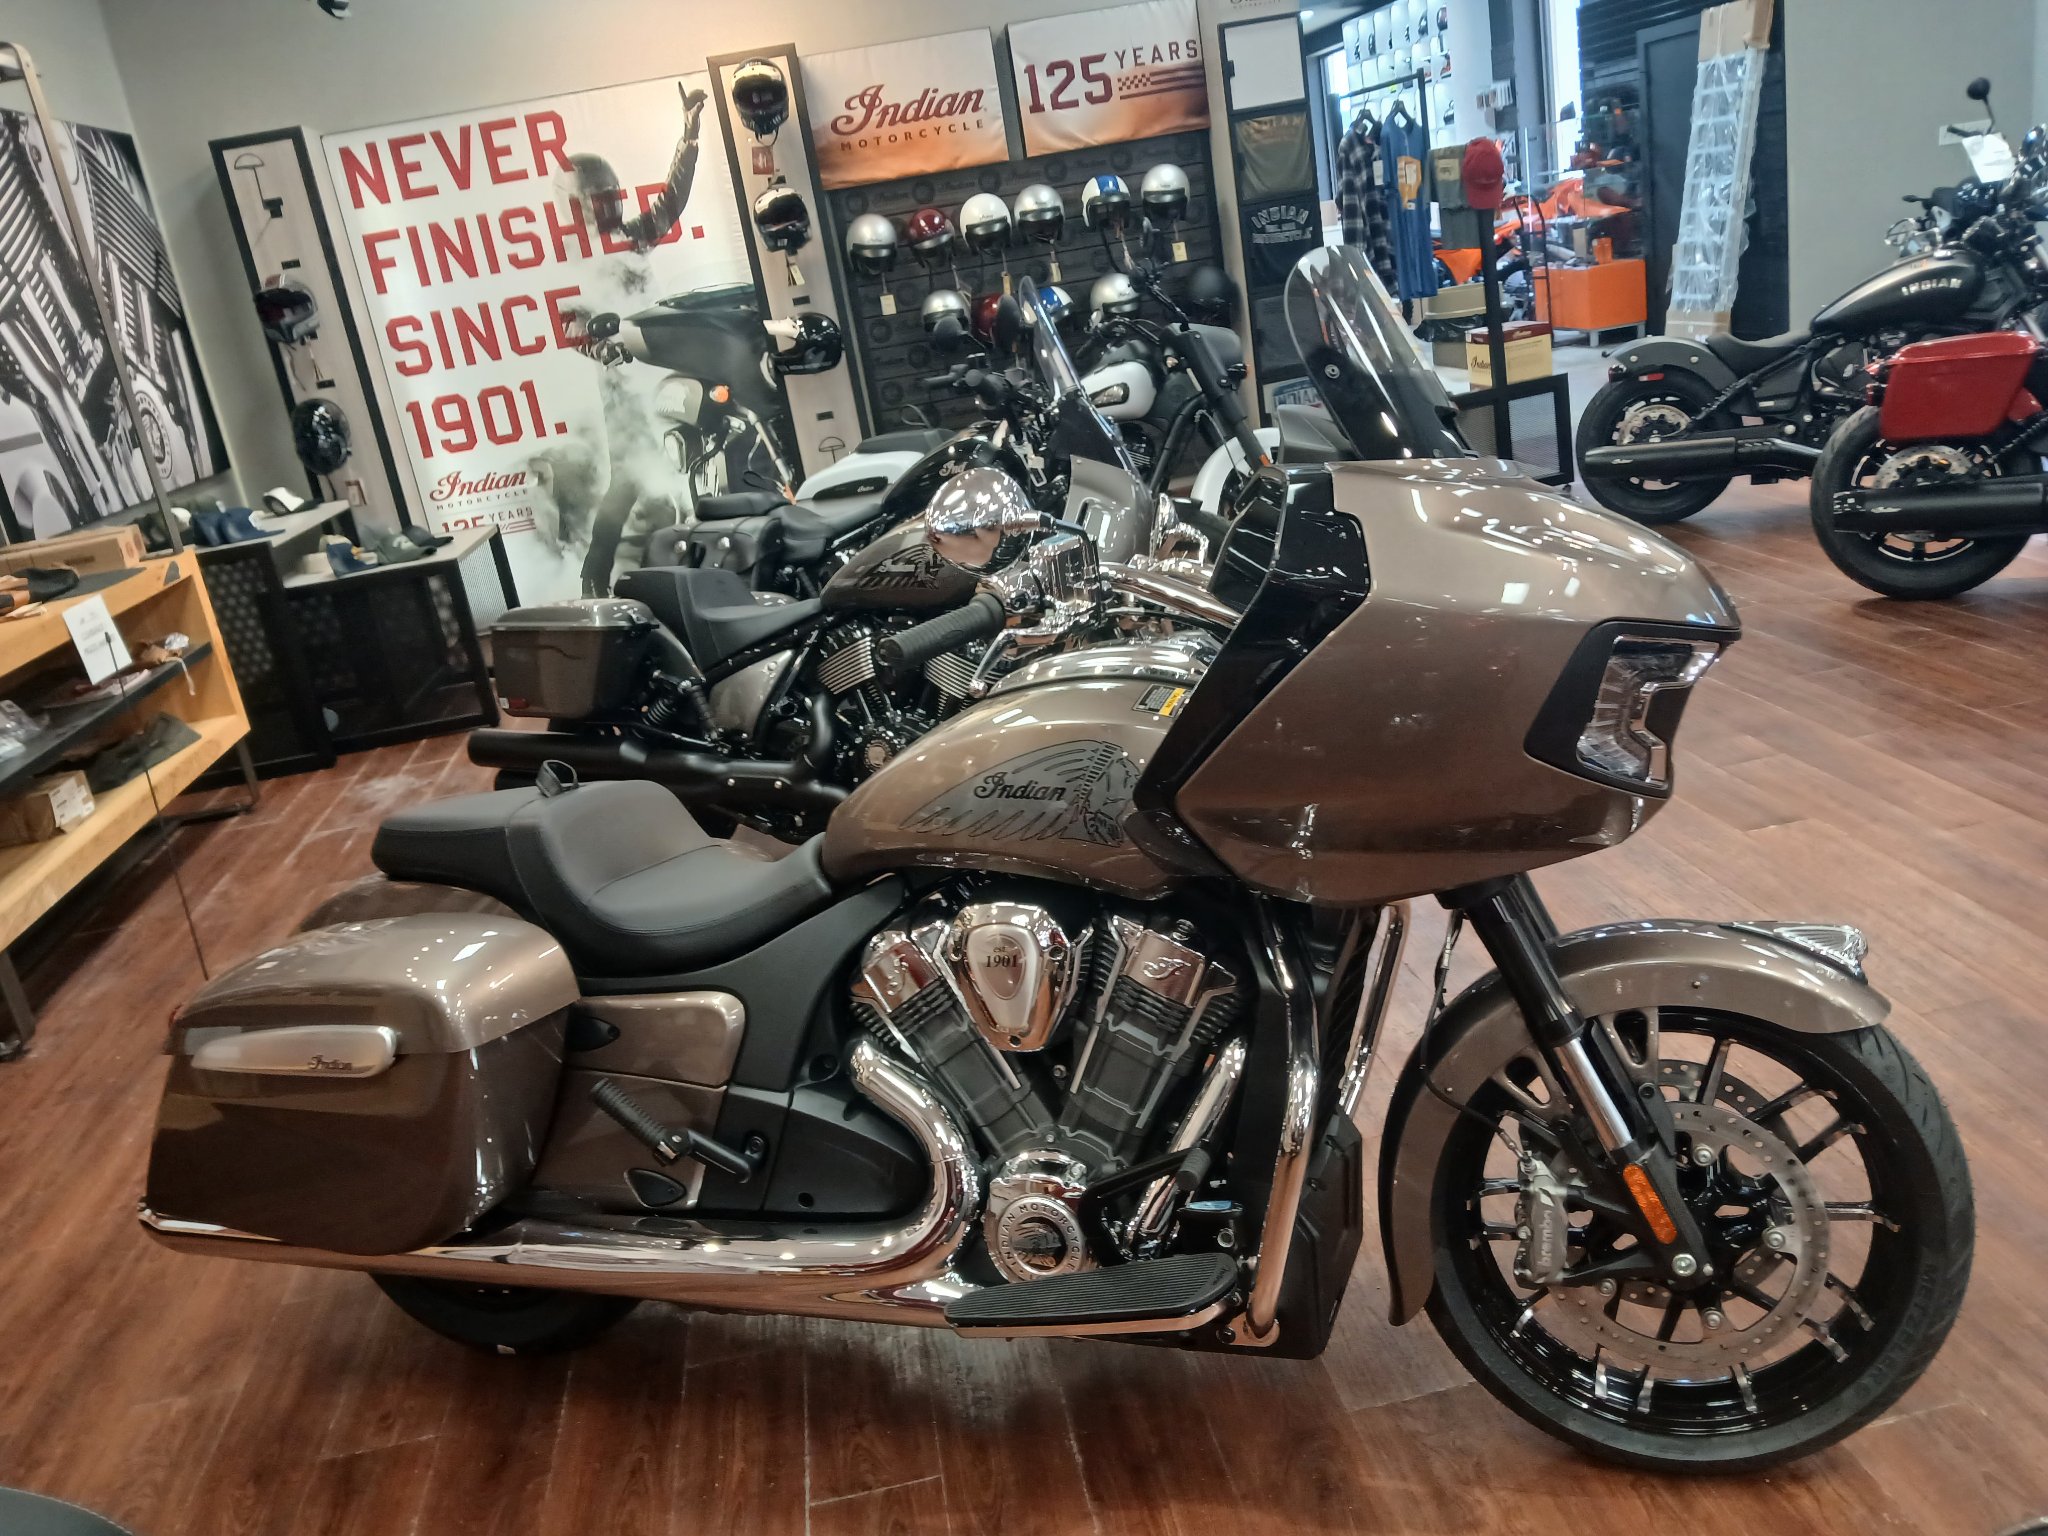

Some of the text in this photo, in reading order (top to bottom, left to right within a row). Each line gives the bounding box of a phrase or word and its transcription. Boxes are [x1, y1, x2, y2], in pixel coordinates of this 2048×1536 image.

[1024, 39, 1198, 114] 125 YEARS
[831, 84, 985, 136] Indian
[840, 118, 984, 151] MOTORCYCLE
[338, 109, 576, 210] NEVER
[361, 182, 705, 295] FINISHED.
[1901, 278, 1962, 296] INDIAN
[385, 285, 595, 378] SINCE
[405, 379, 568, 460] 1901.
[430, 470, 527, 502] Indian
[436, 488, 529, 511] MOTORCYCLE
[488, 506, 534, 523] YEARS
[974, 771, 1067, 802] Indian
[985, 954, 1018, 968] 1901
